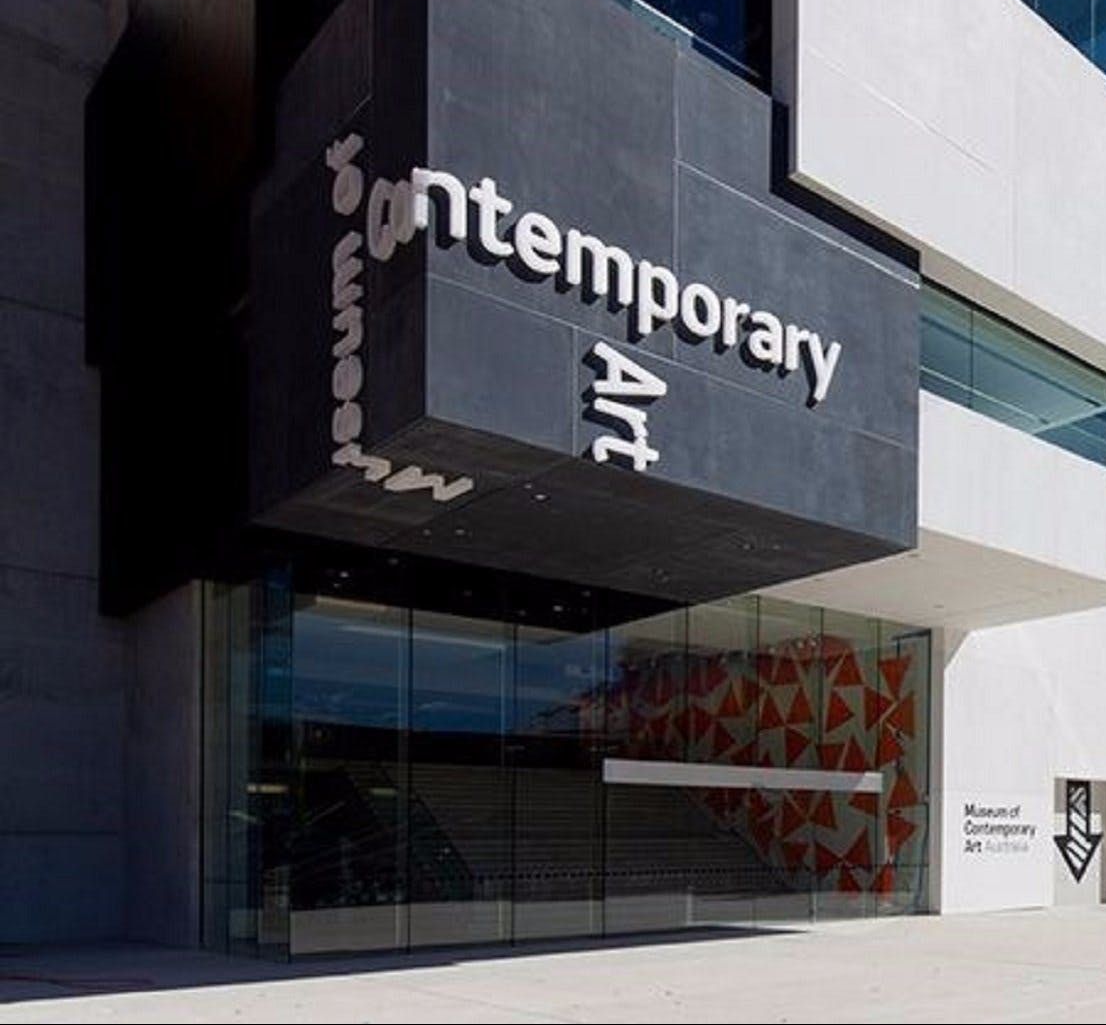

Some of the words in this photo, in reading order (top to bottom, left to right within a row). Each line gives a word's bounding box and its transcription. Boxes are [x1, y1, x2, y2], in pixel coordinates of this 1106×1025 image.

[326, 133, 365, 217] of
[592, 341, 668, 471] Art
[964, 804, 1007, 818] Museum
[1009, 804, 1021, 818] of
[963, 819, 1037, 839] Contemporary
[964, 839, 982, 853] Art
